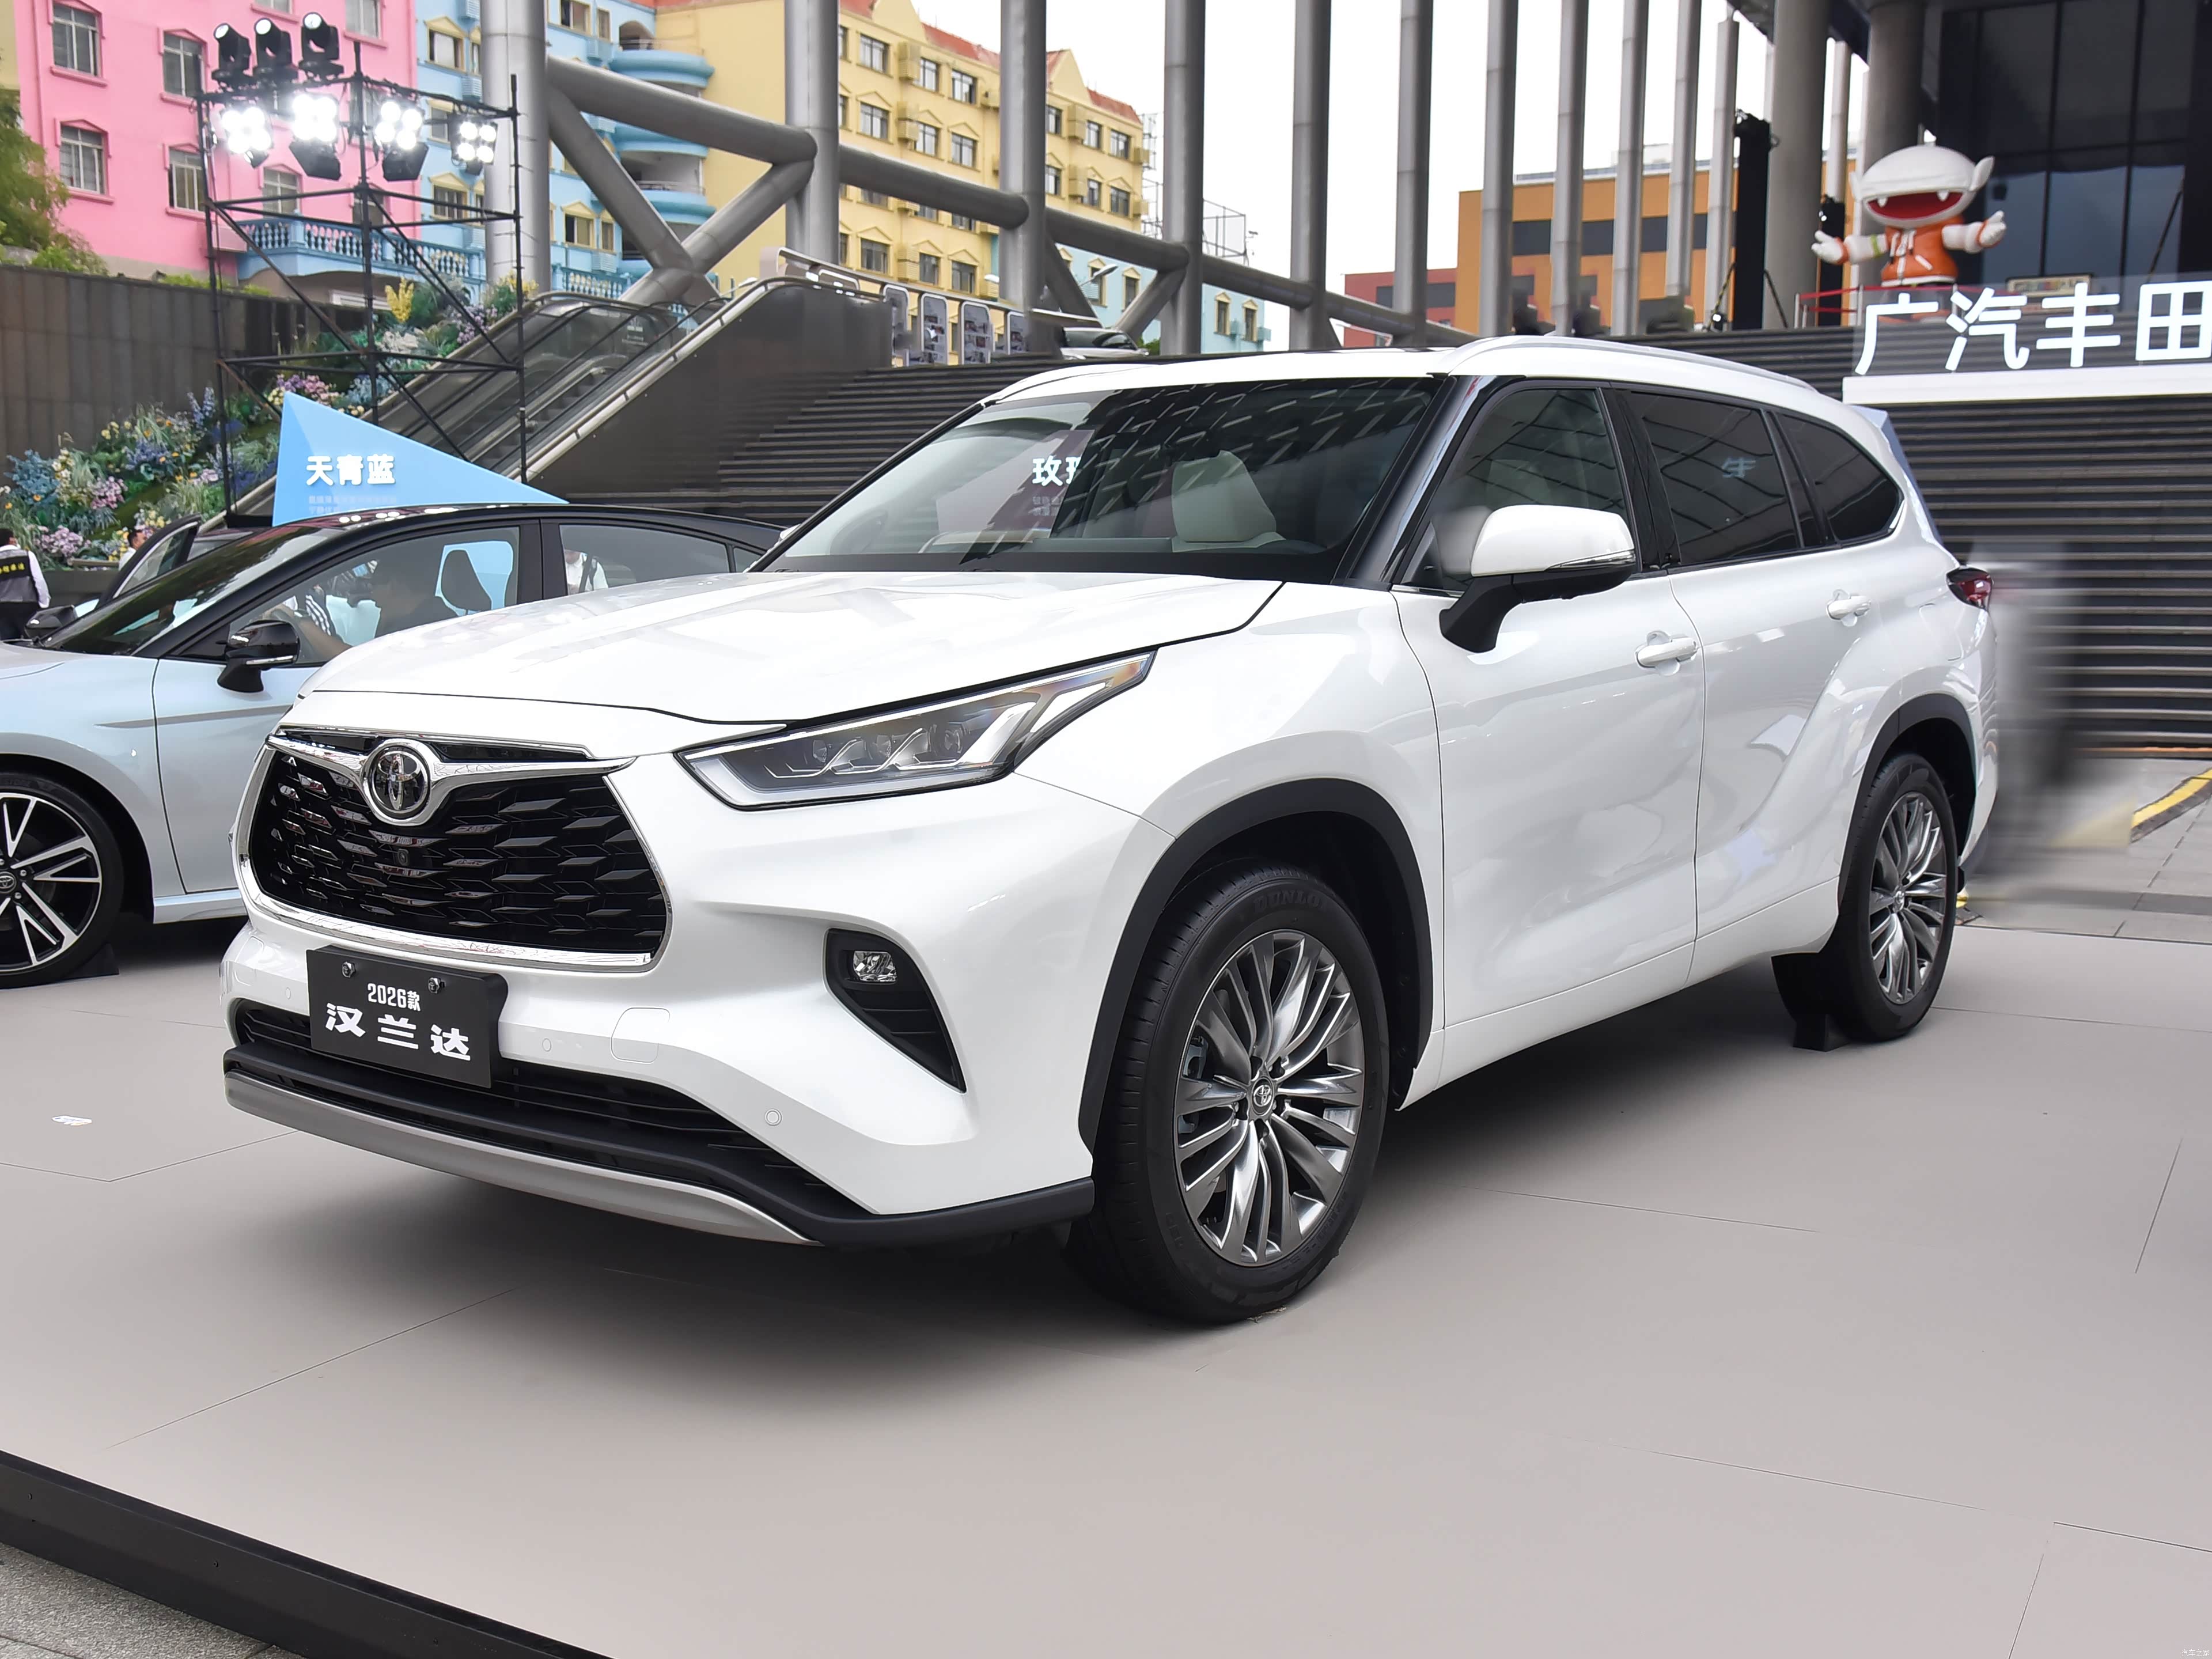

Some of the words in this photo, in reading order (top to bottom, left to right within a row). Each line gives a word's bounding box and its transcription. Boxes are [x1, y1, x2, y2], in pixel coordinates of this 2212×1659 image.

[1854, 281, 2212, 376] 广汽丰田
[306, 453, 396, 486] 天青蓝
[1253, 889, 1327, 914] DUNLO
[367, 982, 421, 1012] 2026款
[325, 1002, 471, 1061] 汉兰达
